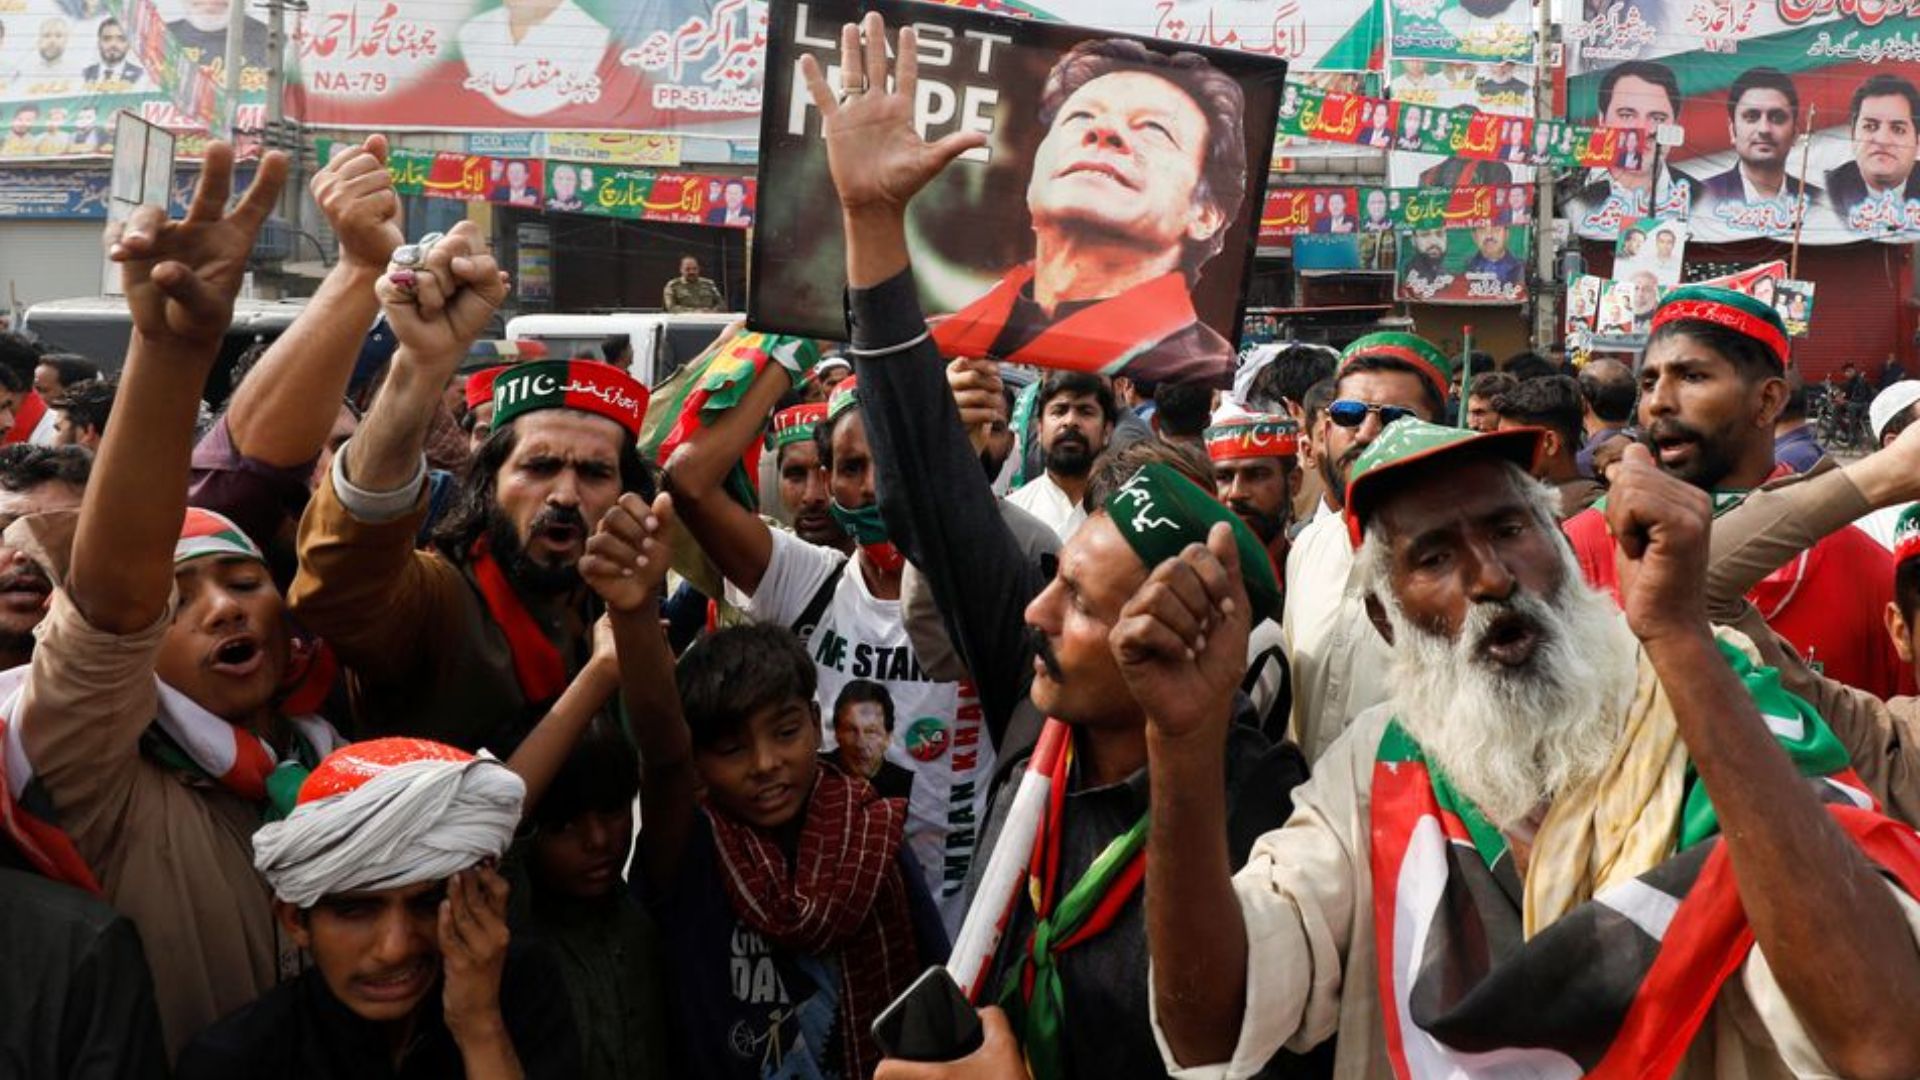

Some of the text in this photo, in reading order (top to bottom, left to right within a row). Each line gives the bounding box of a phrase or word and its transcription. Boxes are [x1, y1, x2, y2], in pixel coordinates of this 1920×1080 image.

[795, 4, 1012, 73] LST
[1241, 1, 1306, 58] لانگ
[314, 71, 386, 91] NA-79
[658, 89, 708, 105] PP-51
[788, 59, 999, 162] HPE
[600, 177, 703, 212] لانگ مارچ
[1441, 187, 1491, 217] لانگ
